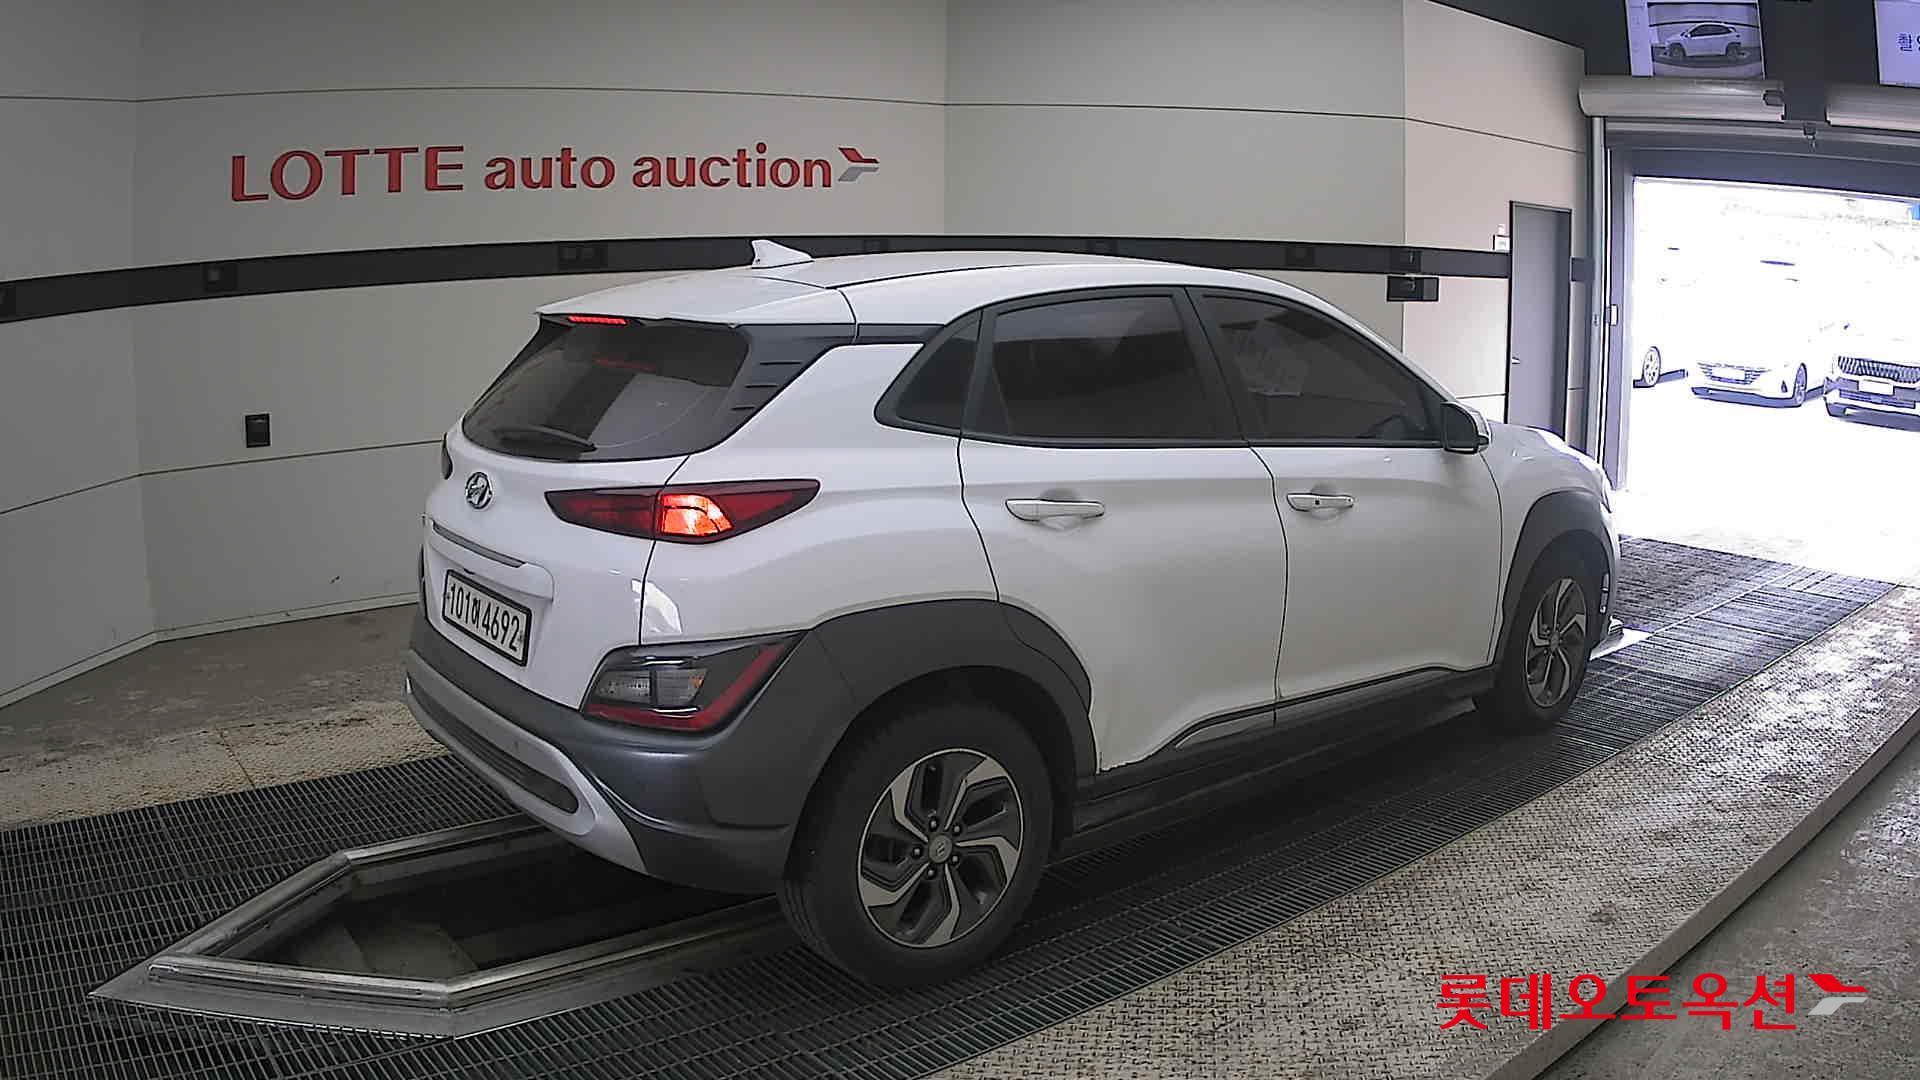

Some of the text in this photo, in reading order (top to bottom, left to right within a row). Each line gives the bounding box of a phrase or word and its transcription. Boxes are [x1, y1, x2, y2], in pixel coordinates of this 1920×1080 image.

[231, 142, 833, 202] LOTTE auto auction
